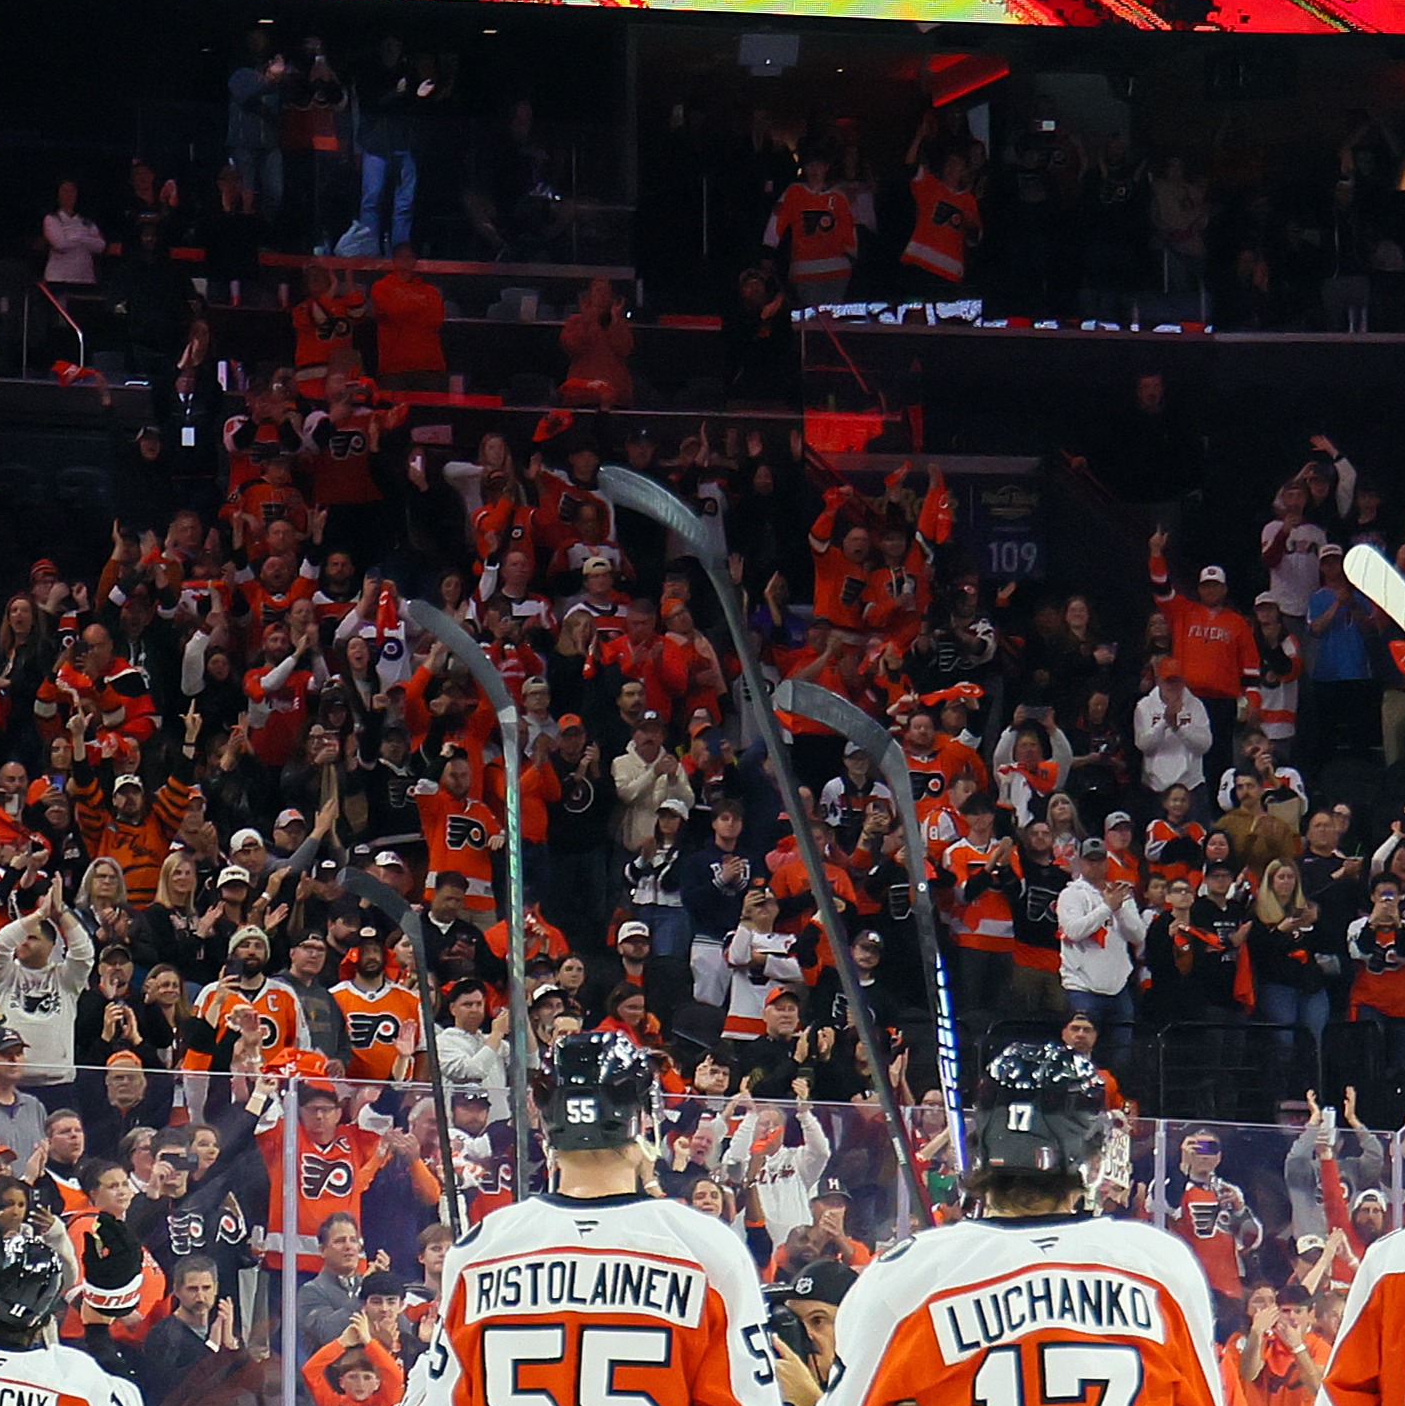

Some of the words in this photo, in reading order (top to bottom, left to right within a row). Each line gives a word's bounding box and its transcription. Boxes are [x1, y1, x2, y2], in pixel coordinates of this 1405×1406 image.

[988, 541, 1038, 573] 109
[1187, 624, 1231, 644] FLYERS
[567, 1099, 596, 1124] 55
[1007, 1104, 1033, 1132] 17
[827, 1177, 840, 1190] H
[476, 1261, 693, 1319] RISTOLAINEN
[945, 1278, 1152, 1352] LUCHANKO
